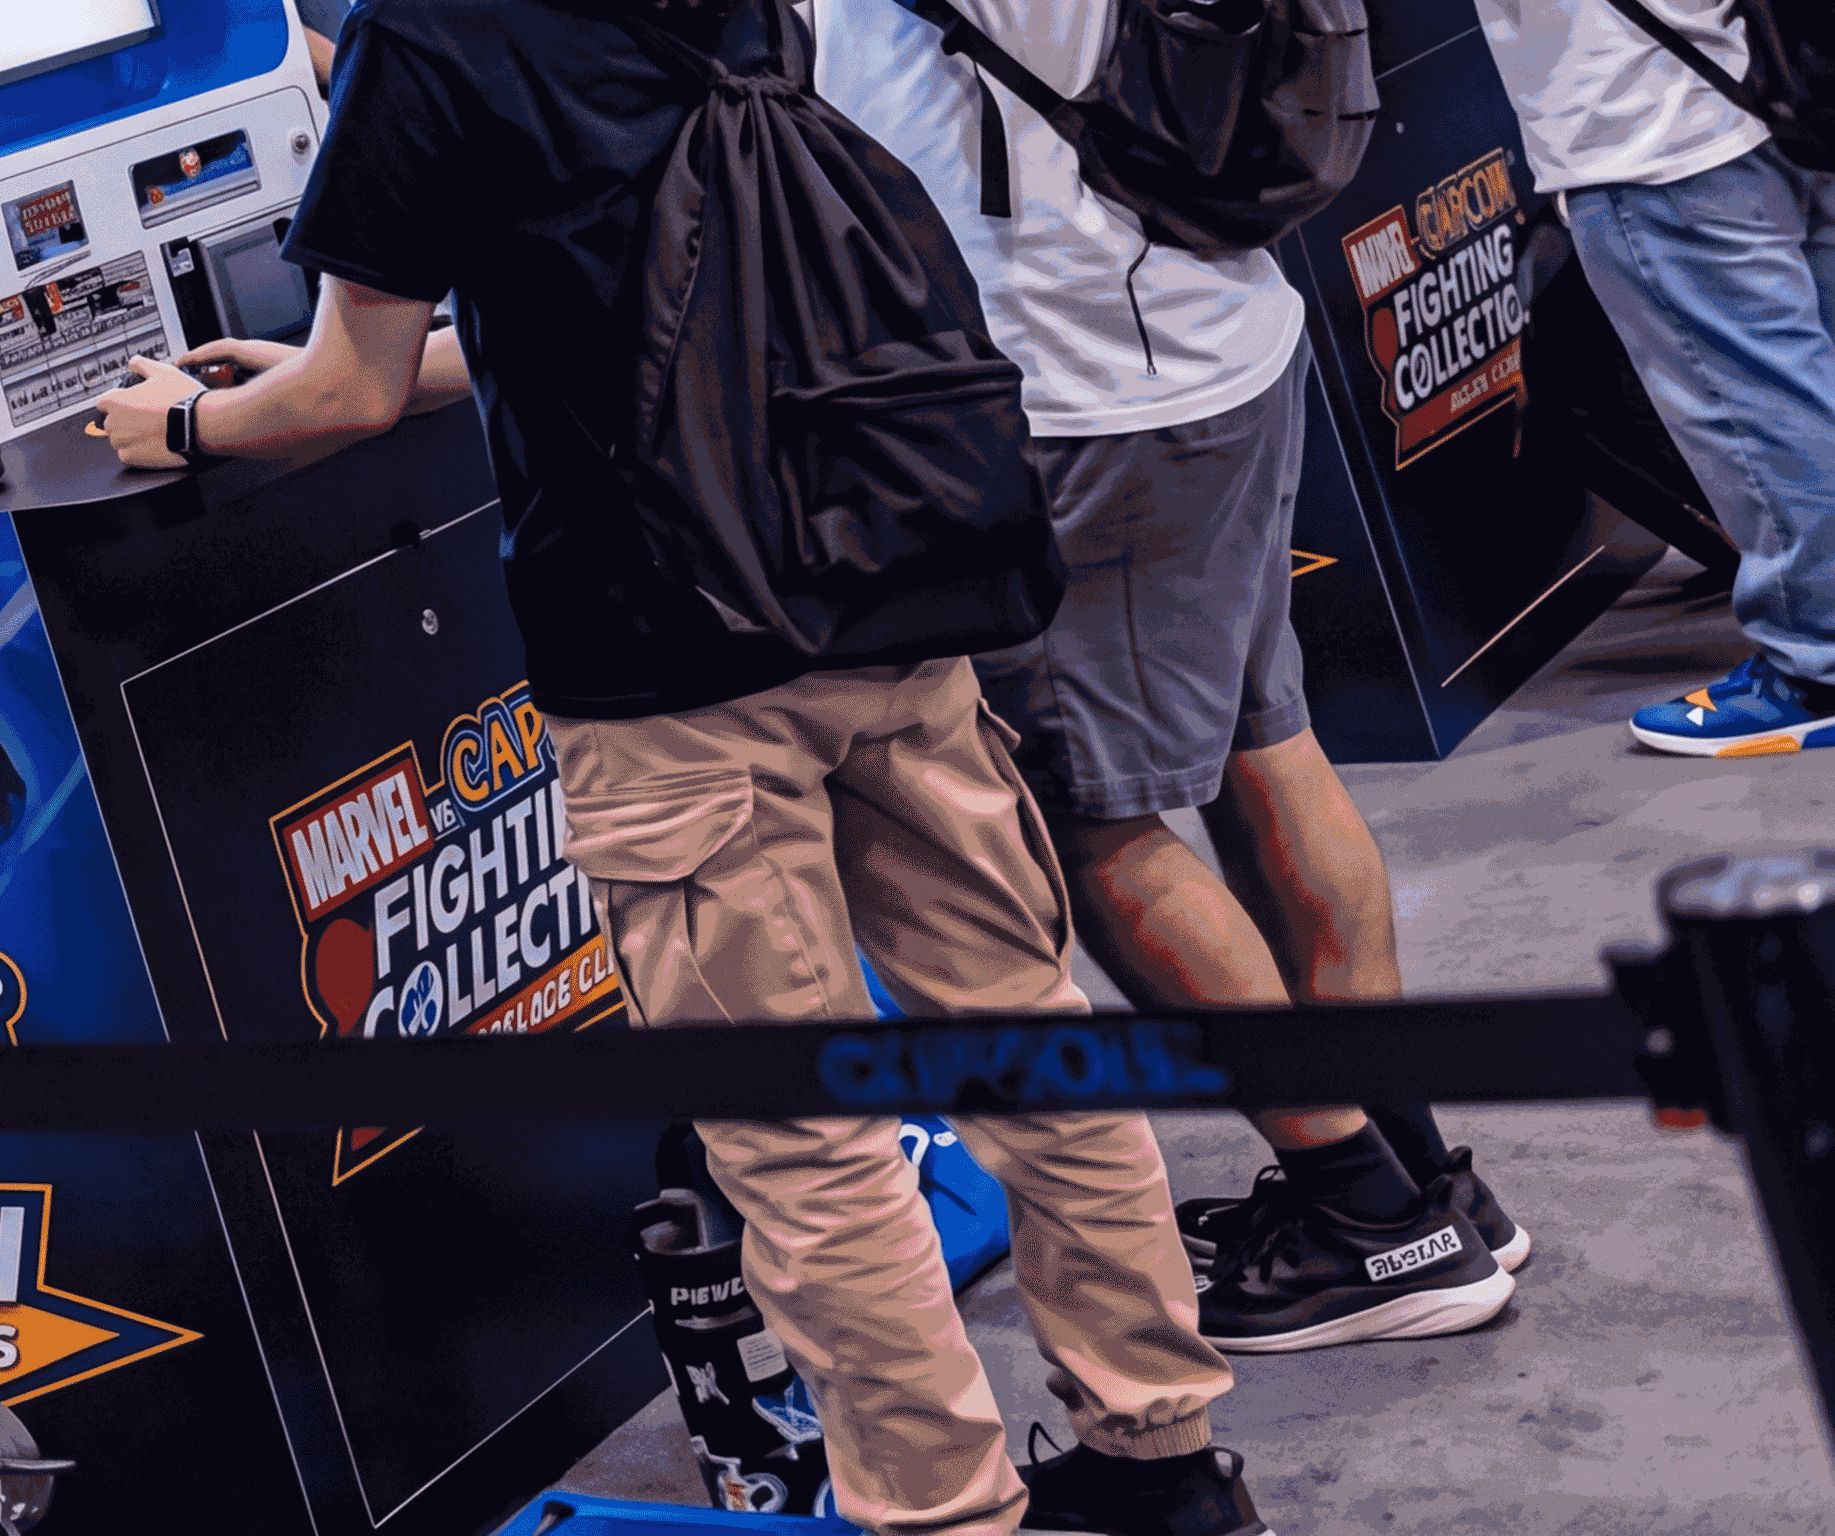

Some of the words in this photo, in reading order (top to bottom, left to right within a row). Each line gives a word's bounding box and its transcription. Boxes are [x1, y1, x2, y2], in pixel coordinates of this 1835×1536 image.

[1393, 224, 1514, 348] FIGHTING
[1394, 283, 1530, 410] COLLECTIO
[292, 769, 429, 912] MARVEL
[452, 701, 545, 802] CAP
[374, 777, 567, 980] FIGHTI
[363, 864, 592, 1040] COLLECTI
